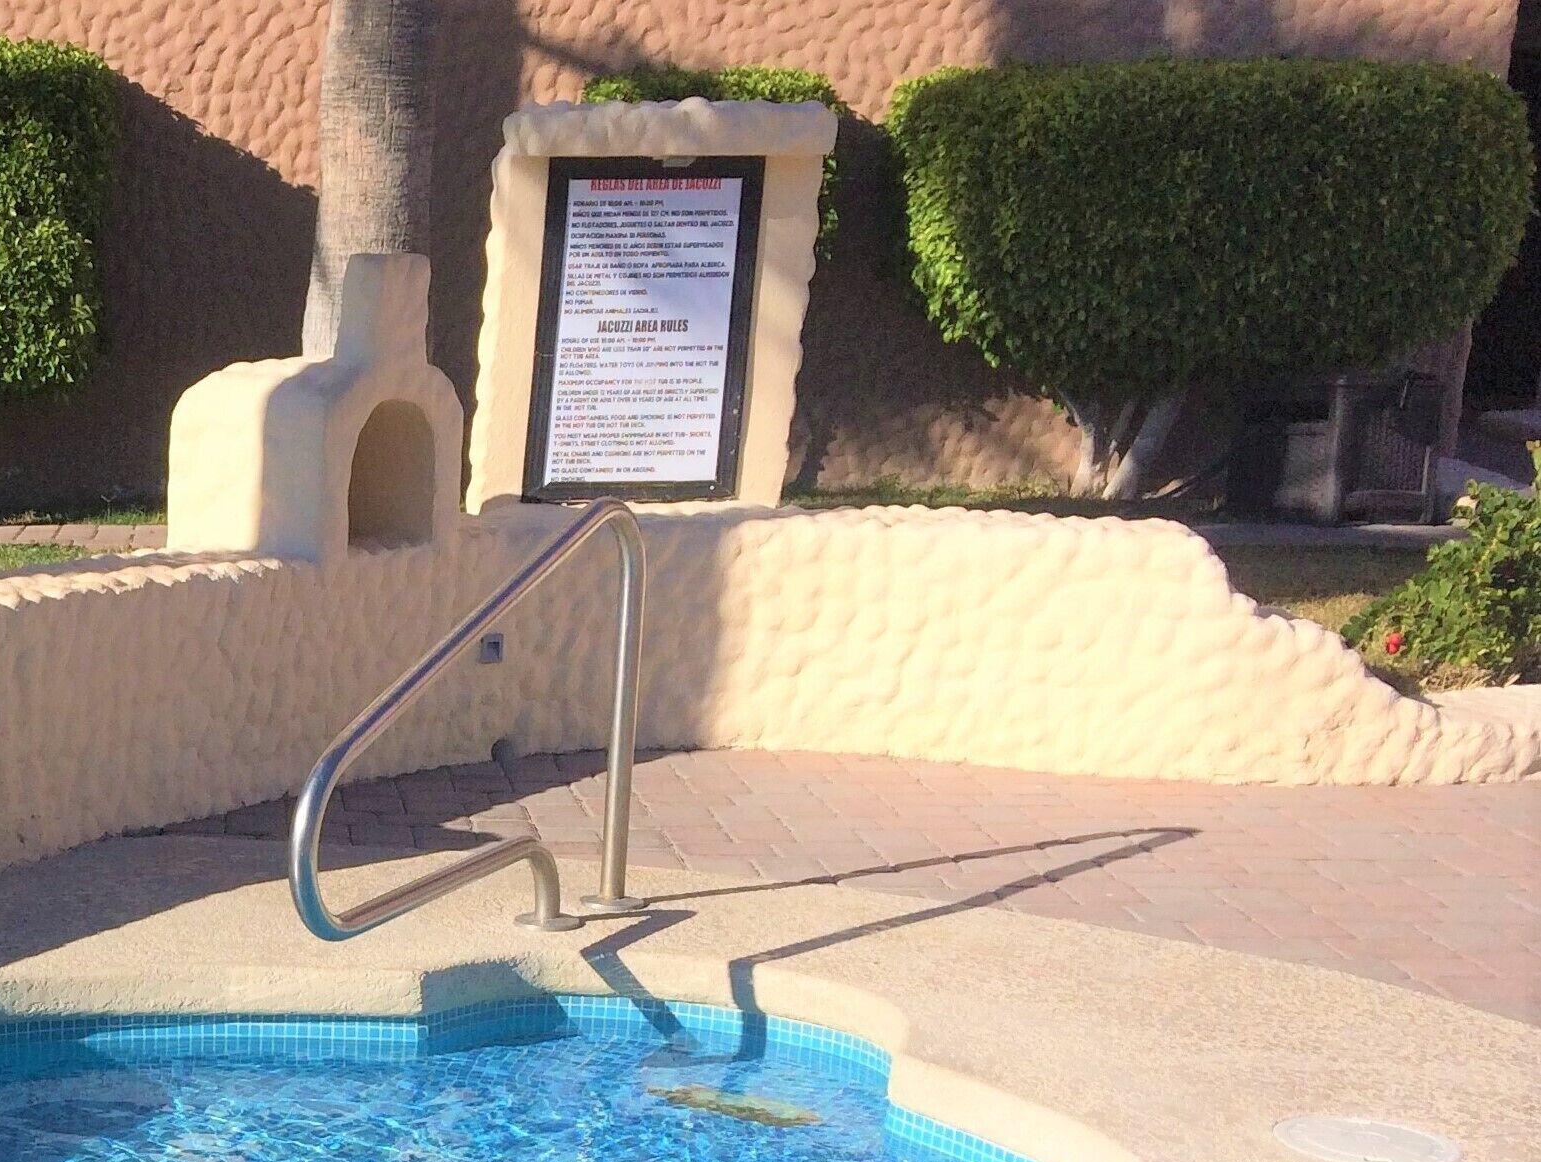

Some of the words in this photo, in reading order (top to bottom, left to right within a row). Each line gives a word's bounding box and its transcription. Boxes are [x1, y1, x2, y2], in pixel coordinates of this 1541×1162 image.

[597, 320, 633, 333] JACUZZI
[634, 320, 658, 333] AREA
[659, 320, 688, 332] RULES
